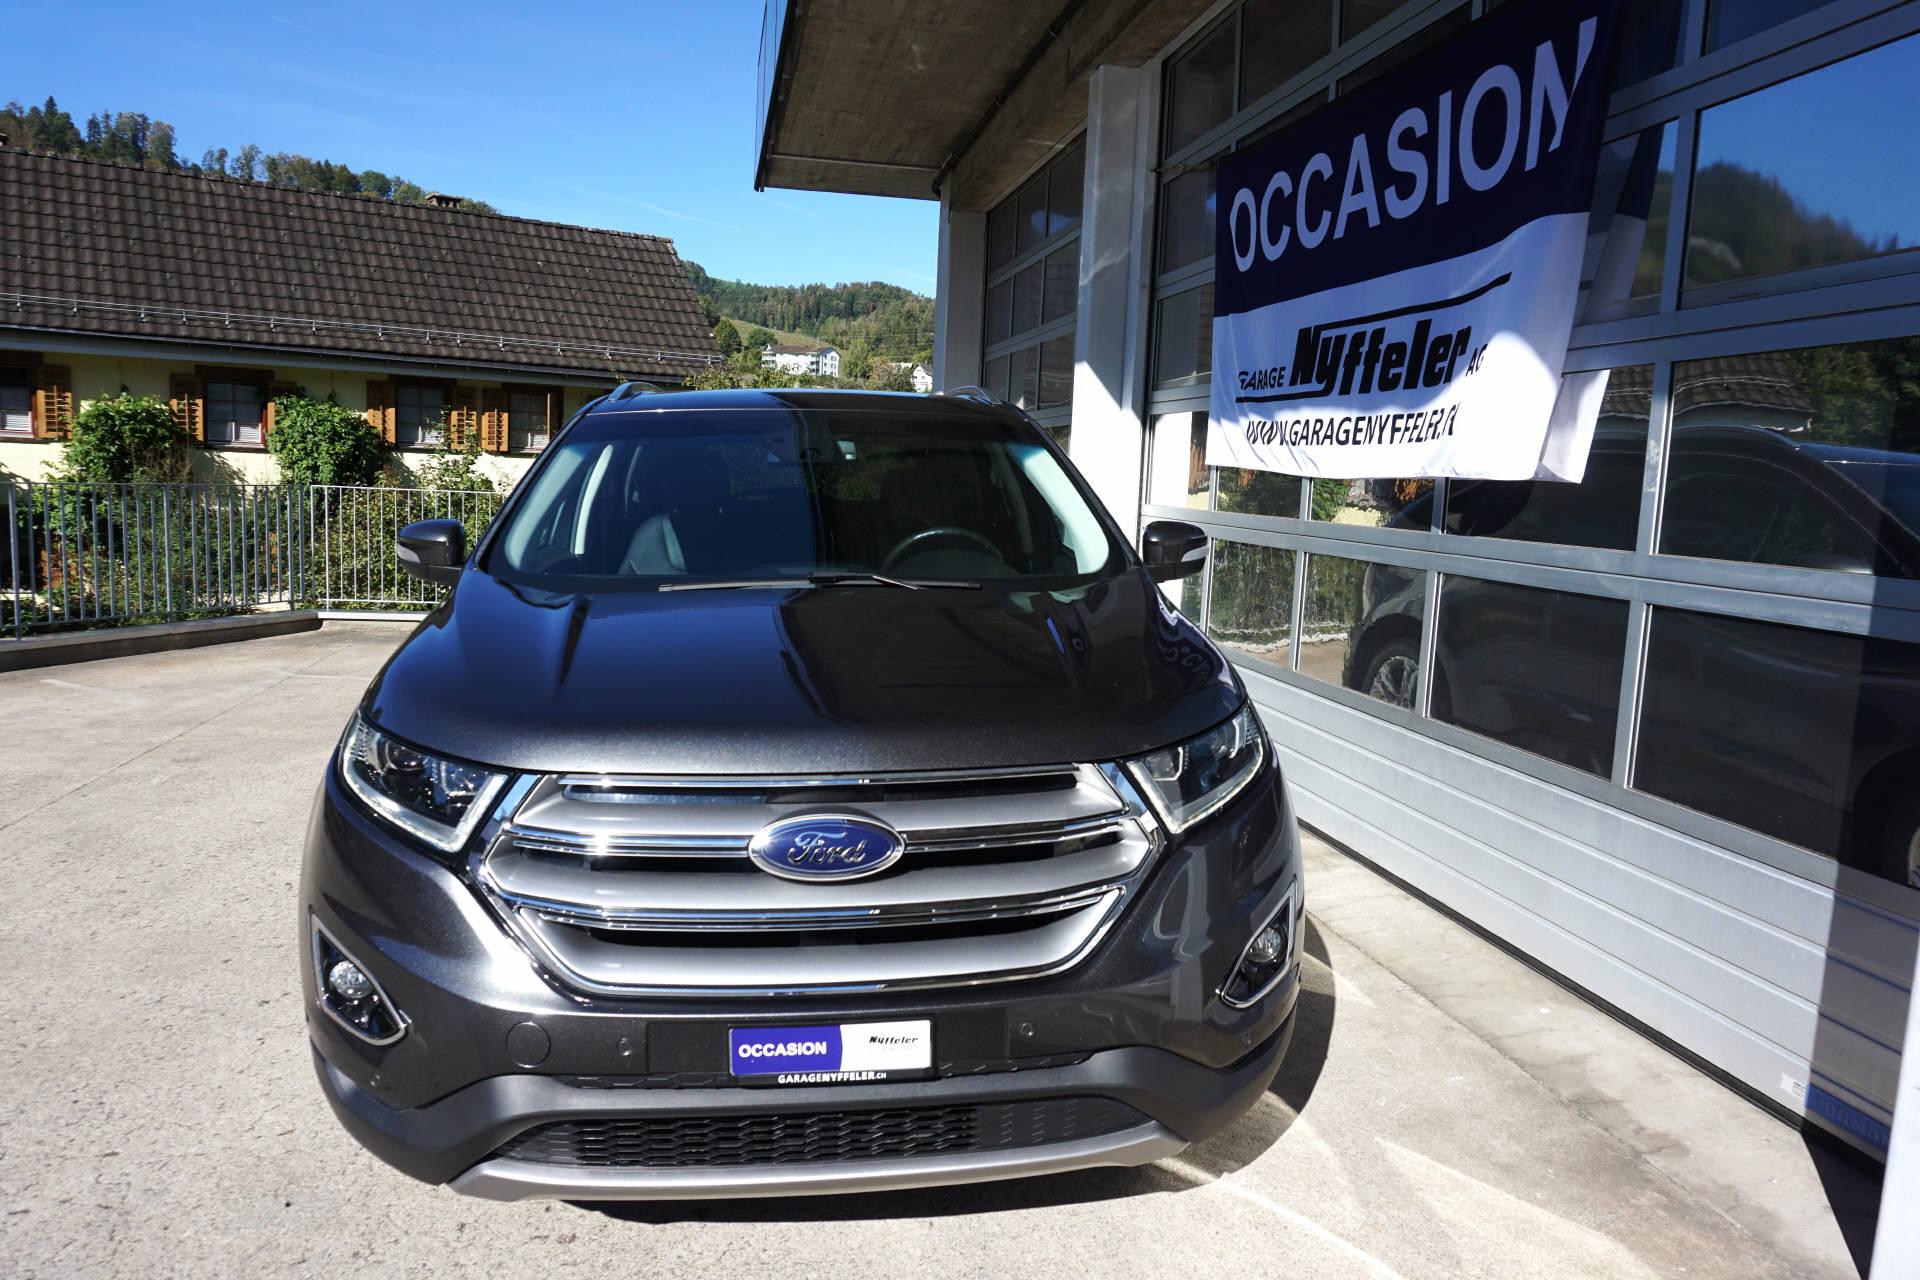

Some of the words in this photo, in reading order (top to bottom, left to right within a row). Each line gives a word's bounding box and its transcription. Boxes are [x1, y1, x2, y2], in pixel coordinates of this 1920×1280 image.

[1230, 16, 1597, 272] OCCASION
[1238, 366, 1287, 390] GARAGE
[1289, 319, 1472, 396] Nyffeler
[787, 831, 868, 864] Ford
[738, 1041, 827, 1058] OCCASION
[778, 1071, 887, 1084] GARAGENYFFELER.CH
